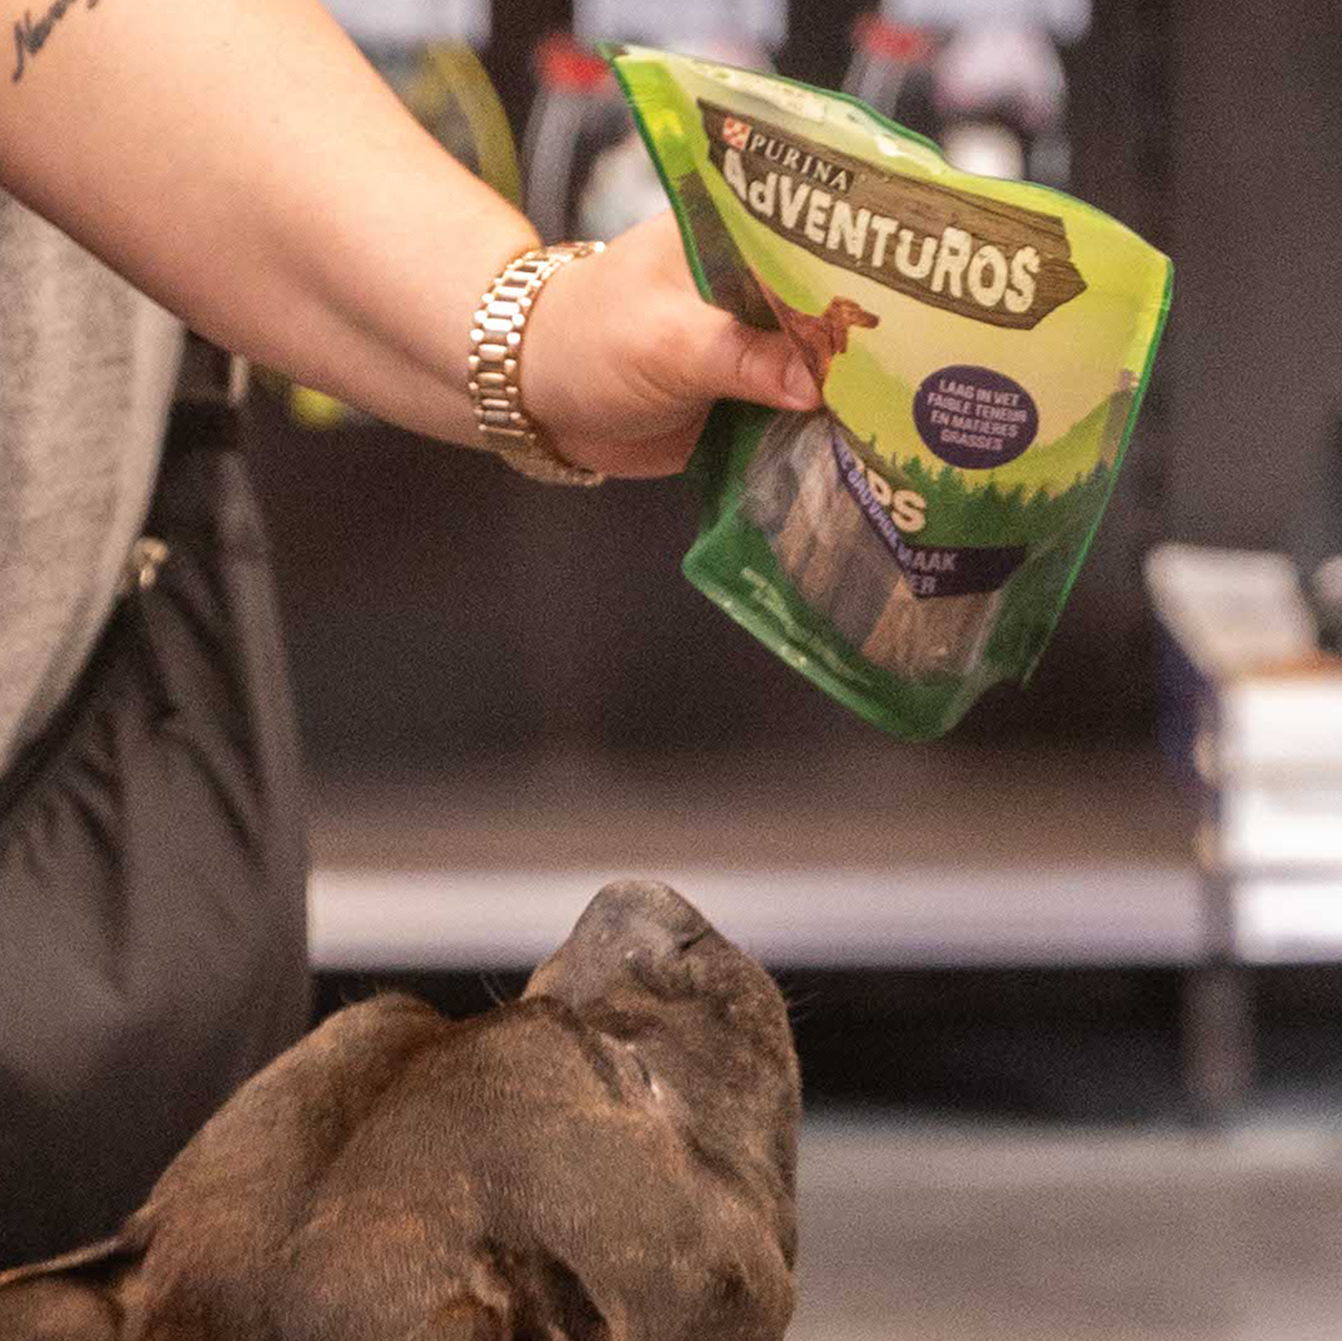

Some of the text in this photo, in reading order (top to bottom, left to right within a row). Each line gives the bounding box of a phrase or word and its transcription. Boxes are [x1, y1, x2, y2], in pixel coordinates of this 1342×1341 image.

[749, 133, 850, 193] PURINA
[939, 379, 1020, 406] LAAG IN VET
[930, 409, 949, 425] EN
